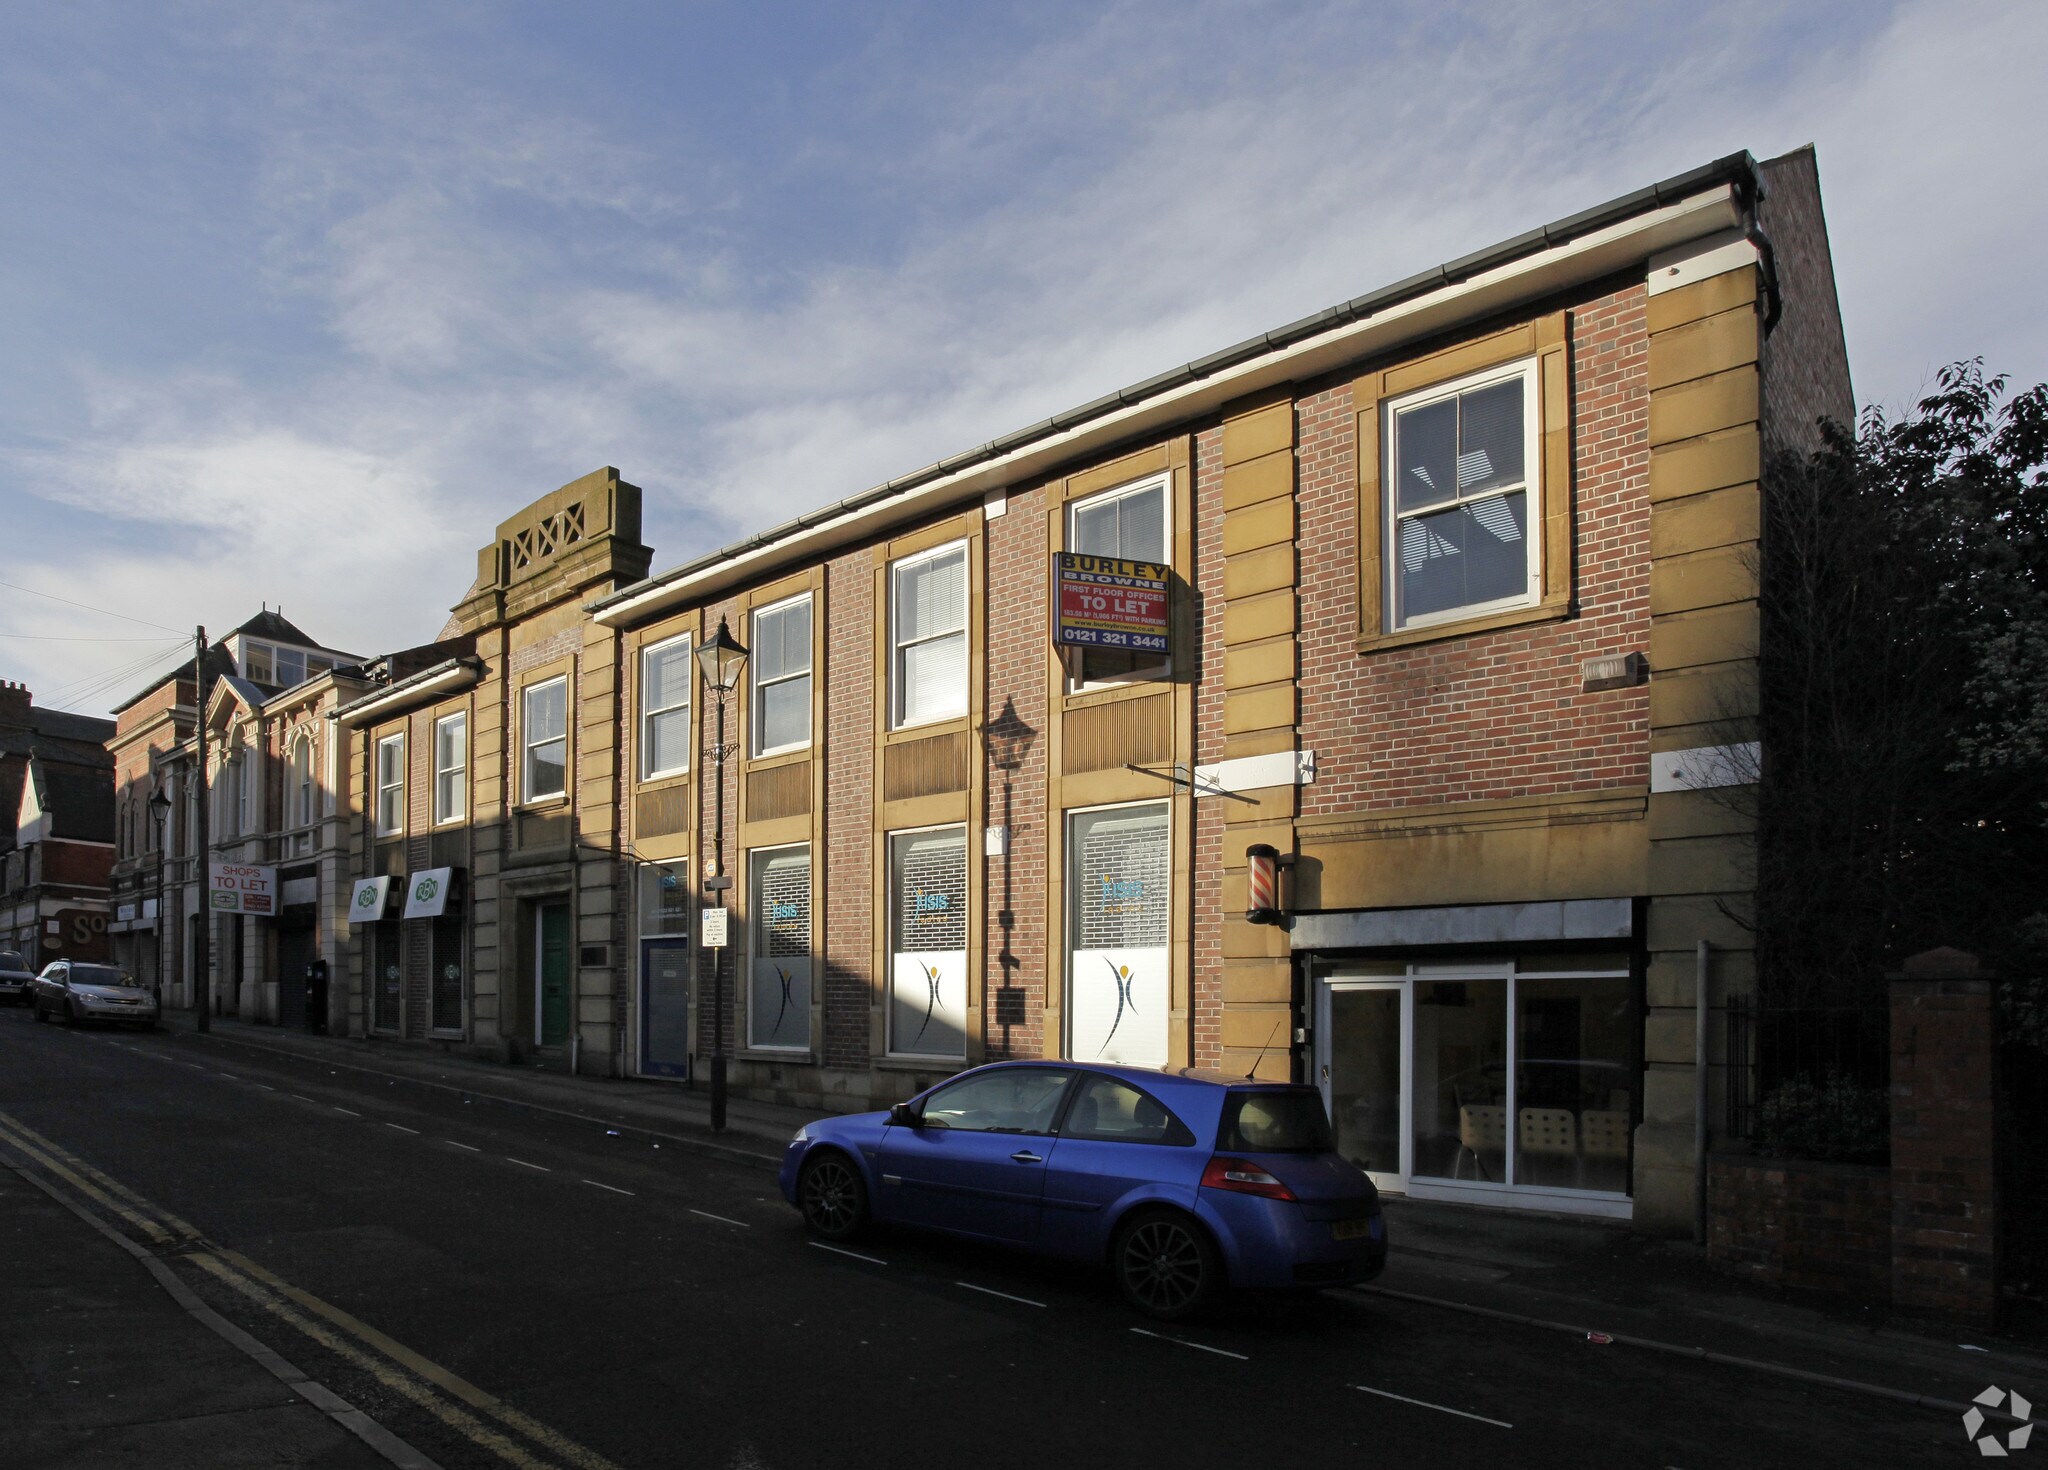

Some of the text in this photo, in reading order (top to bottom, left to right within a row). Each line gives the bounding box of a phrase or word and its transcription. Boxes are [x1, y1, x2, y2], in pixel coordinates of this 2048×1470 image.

[1061, 554, 1166, 579] BURLEY
[1063, 571, 1165, 590] BROWNE
[1063, 584, 1165, 602] FIRST FLOOR OFFICES
[1080, 595, 1150, 615] TO LET
[1125, 615, 1140, 623] WITH
[1140, 617, 1166, 626] PARKING
[1064, 629, 1166, 649] 0121 321 3441
[223, 866, 261, 877] SHOPS
[215, 876, 268, 891] TO LET
